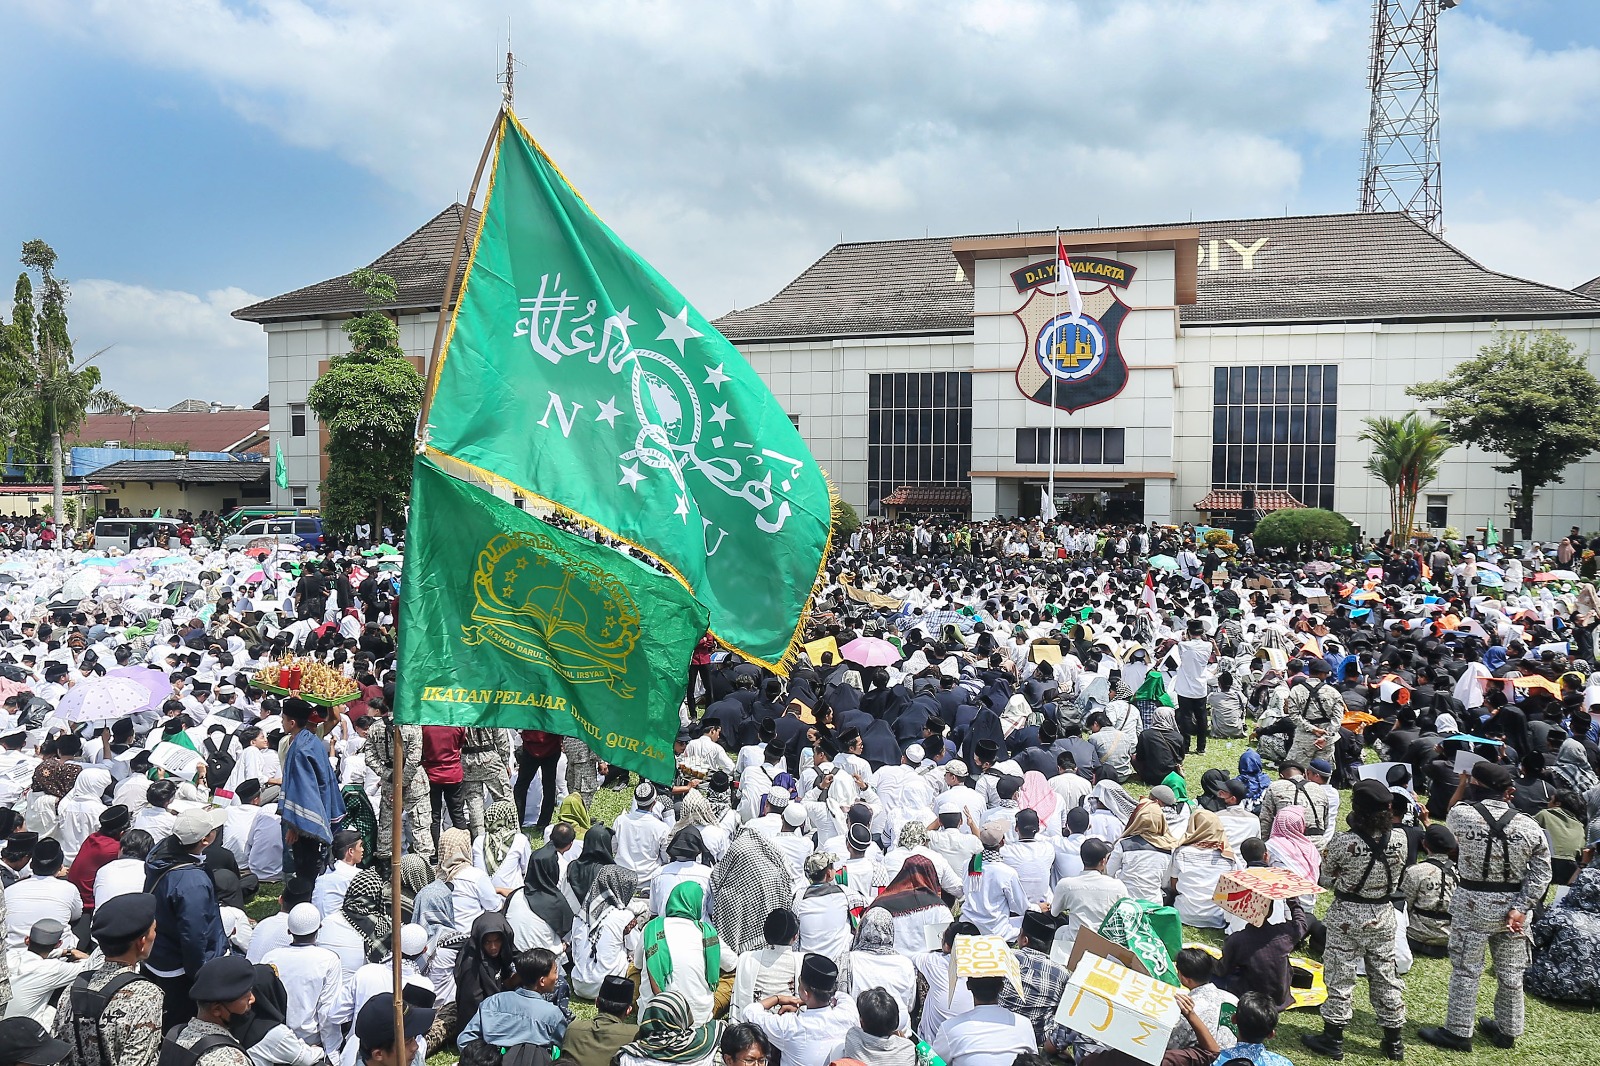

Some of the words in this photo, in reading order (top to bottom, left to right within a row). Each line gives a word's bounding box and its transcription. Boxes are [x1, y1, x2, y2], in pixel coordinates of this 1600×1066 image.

[536, 390, 583, 438] N
[517, 645, 544, 660] DARUL
[576, 670, 605, 679] IRSYAD
[421, 686, 493, 704] IKATAN
[493, 690, 567, 711] PELAJAR
